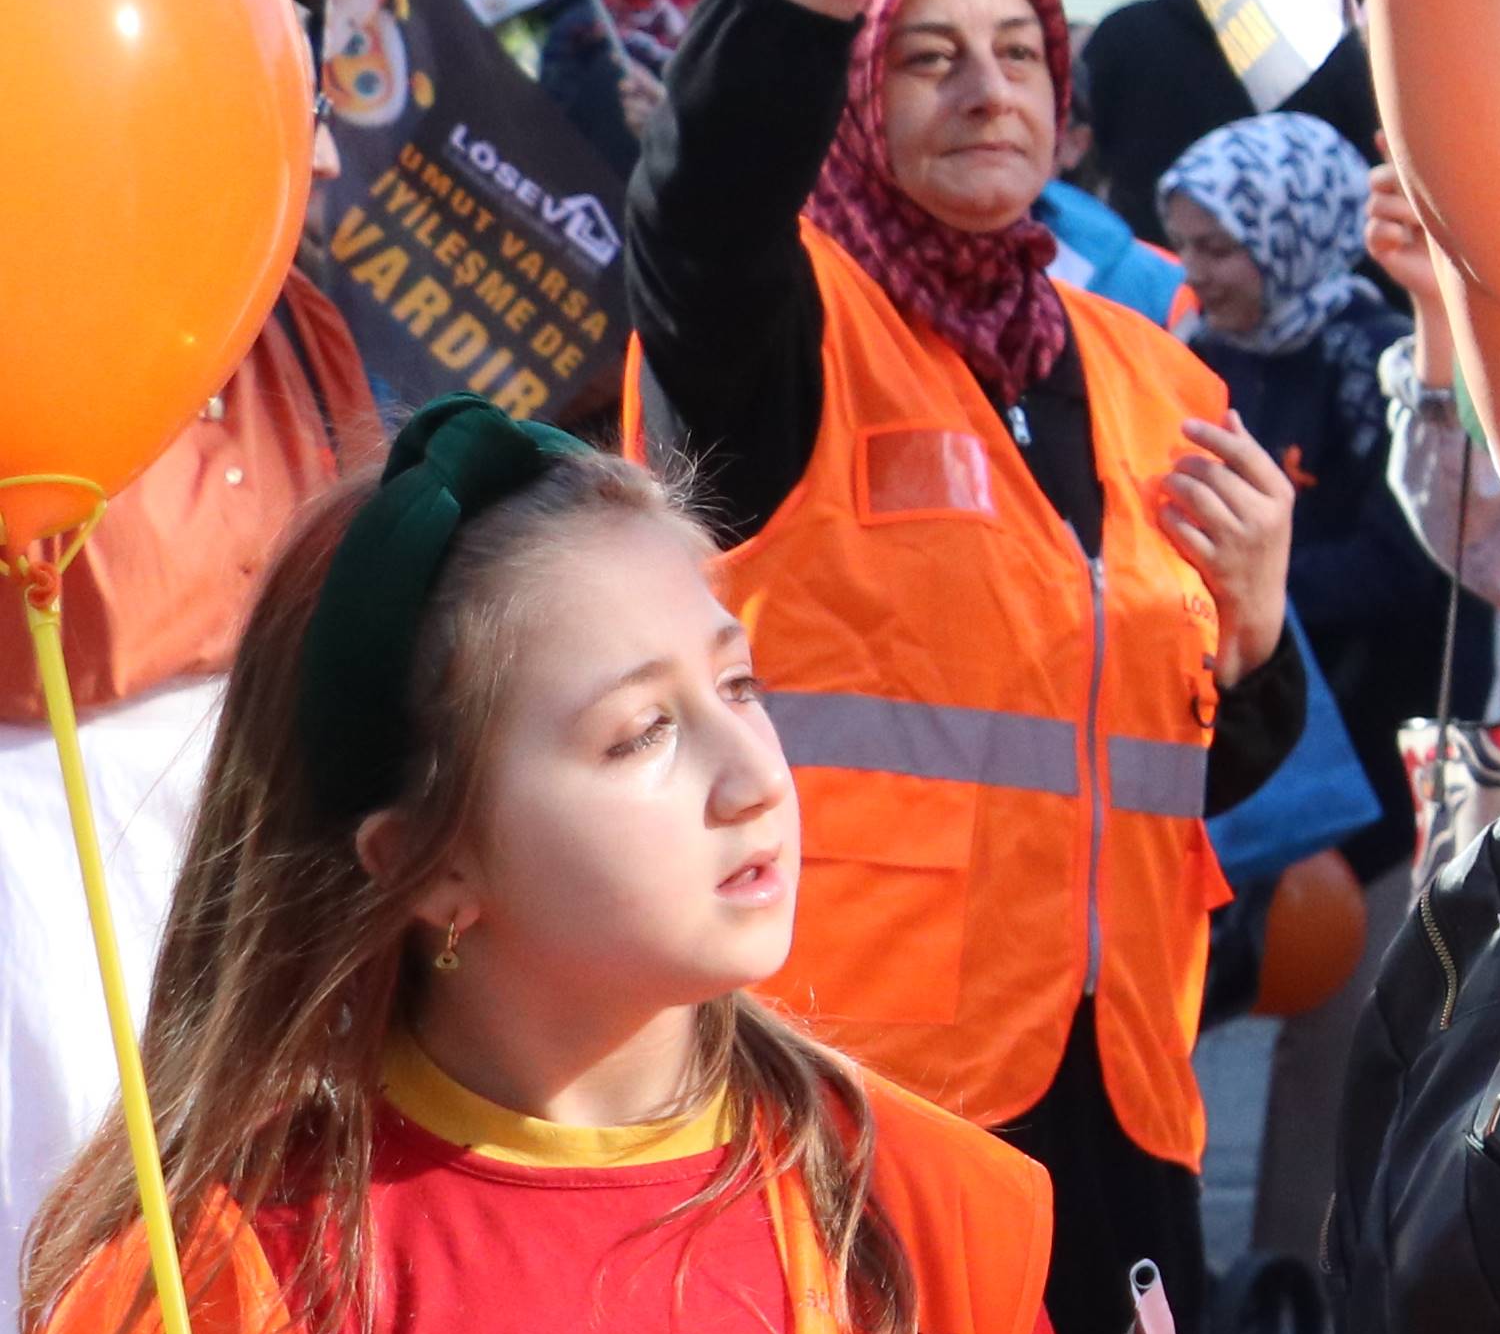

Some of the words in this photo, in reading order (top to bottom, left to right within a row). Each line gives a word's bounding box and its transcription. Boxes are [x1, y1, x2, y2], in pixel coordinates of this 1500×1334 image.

[329, 205, 549, 421] VARDIR
[399, 142, 496, 233] UMUT
[500, 230, 608, 343] VARSA
[530, 322, 585, 379] DE
